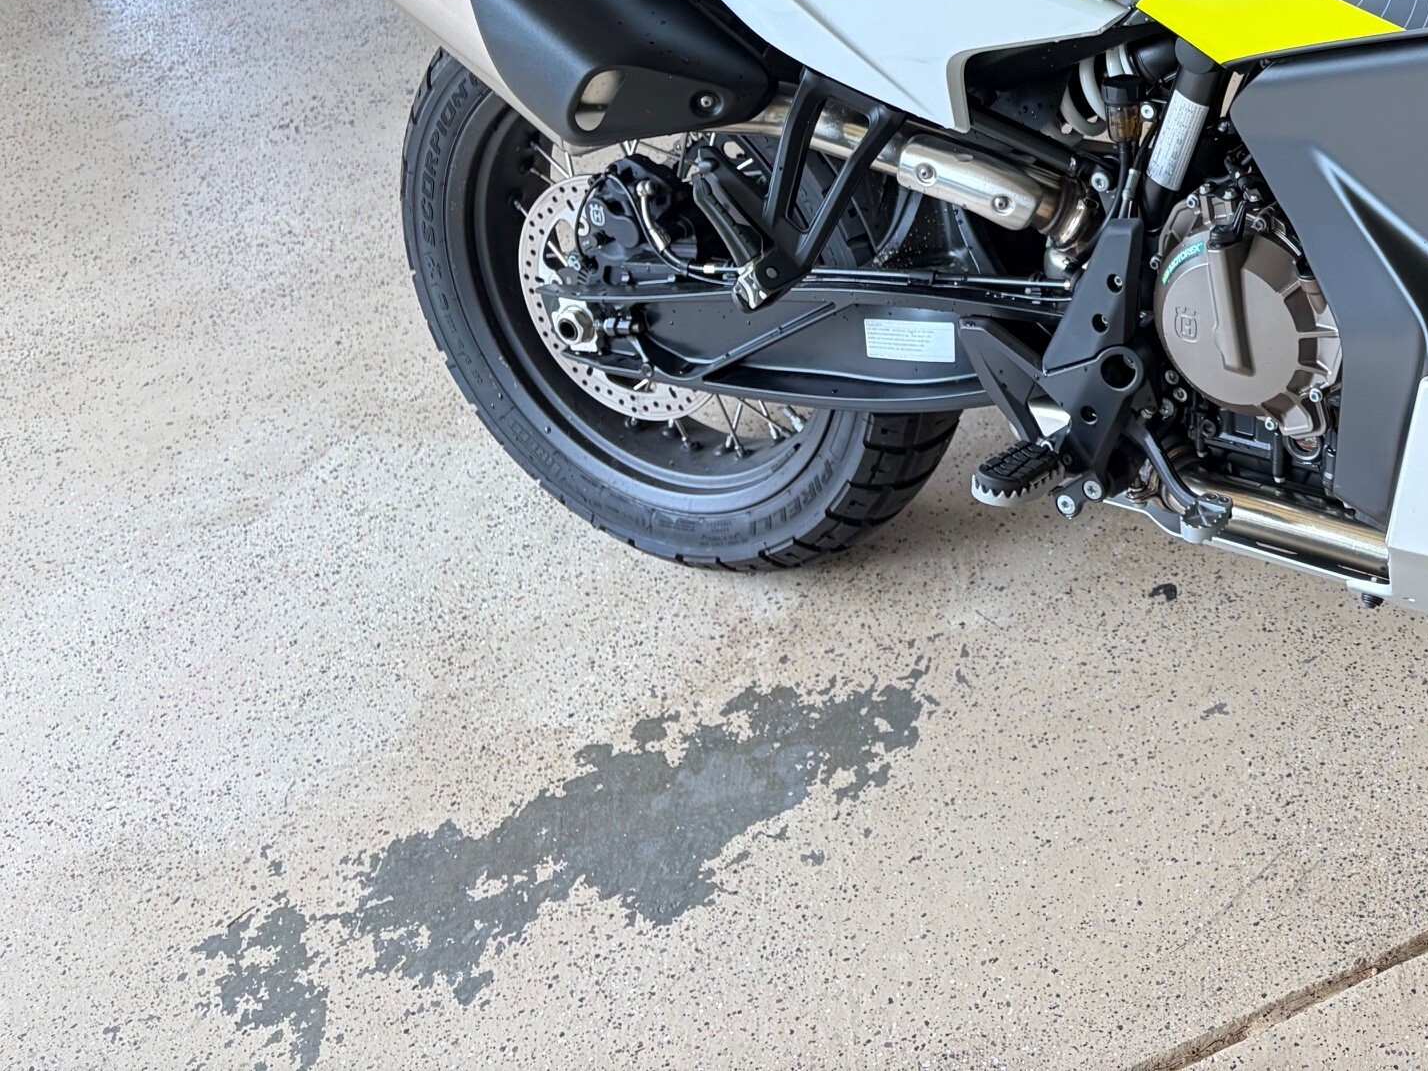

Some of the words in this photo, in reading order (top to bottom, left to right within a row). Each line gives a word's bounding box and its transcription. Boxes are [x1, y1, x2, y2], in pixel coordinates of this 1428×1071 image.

[420, 80, 468, 247] SCORPION
[1168, 243, 1201, 273] MOTOREX
[749, 458, 835, 537] PIRELLI
